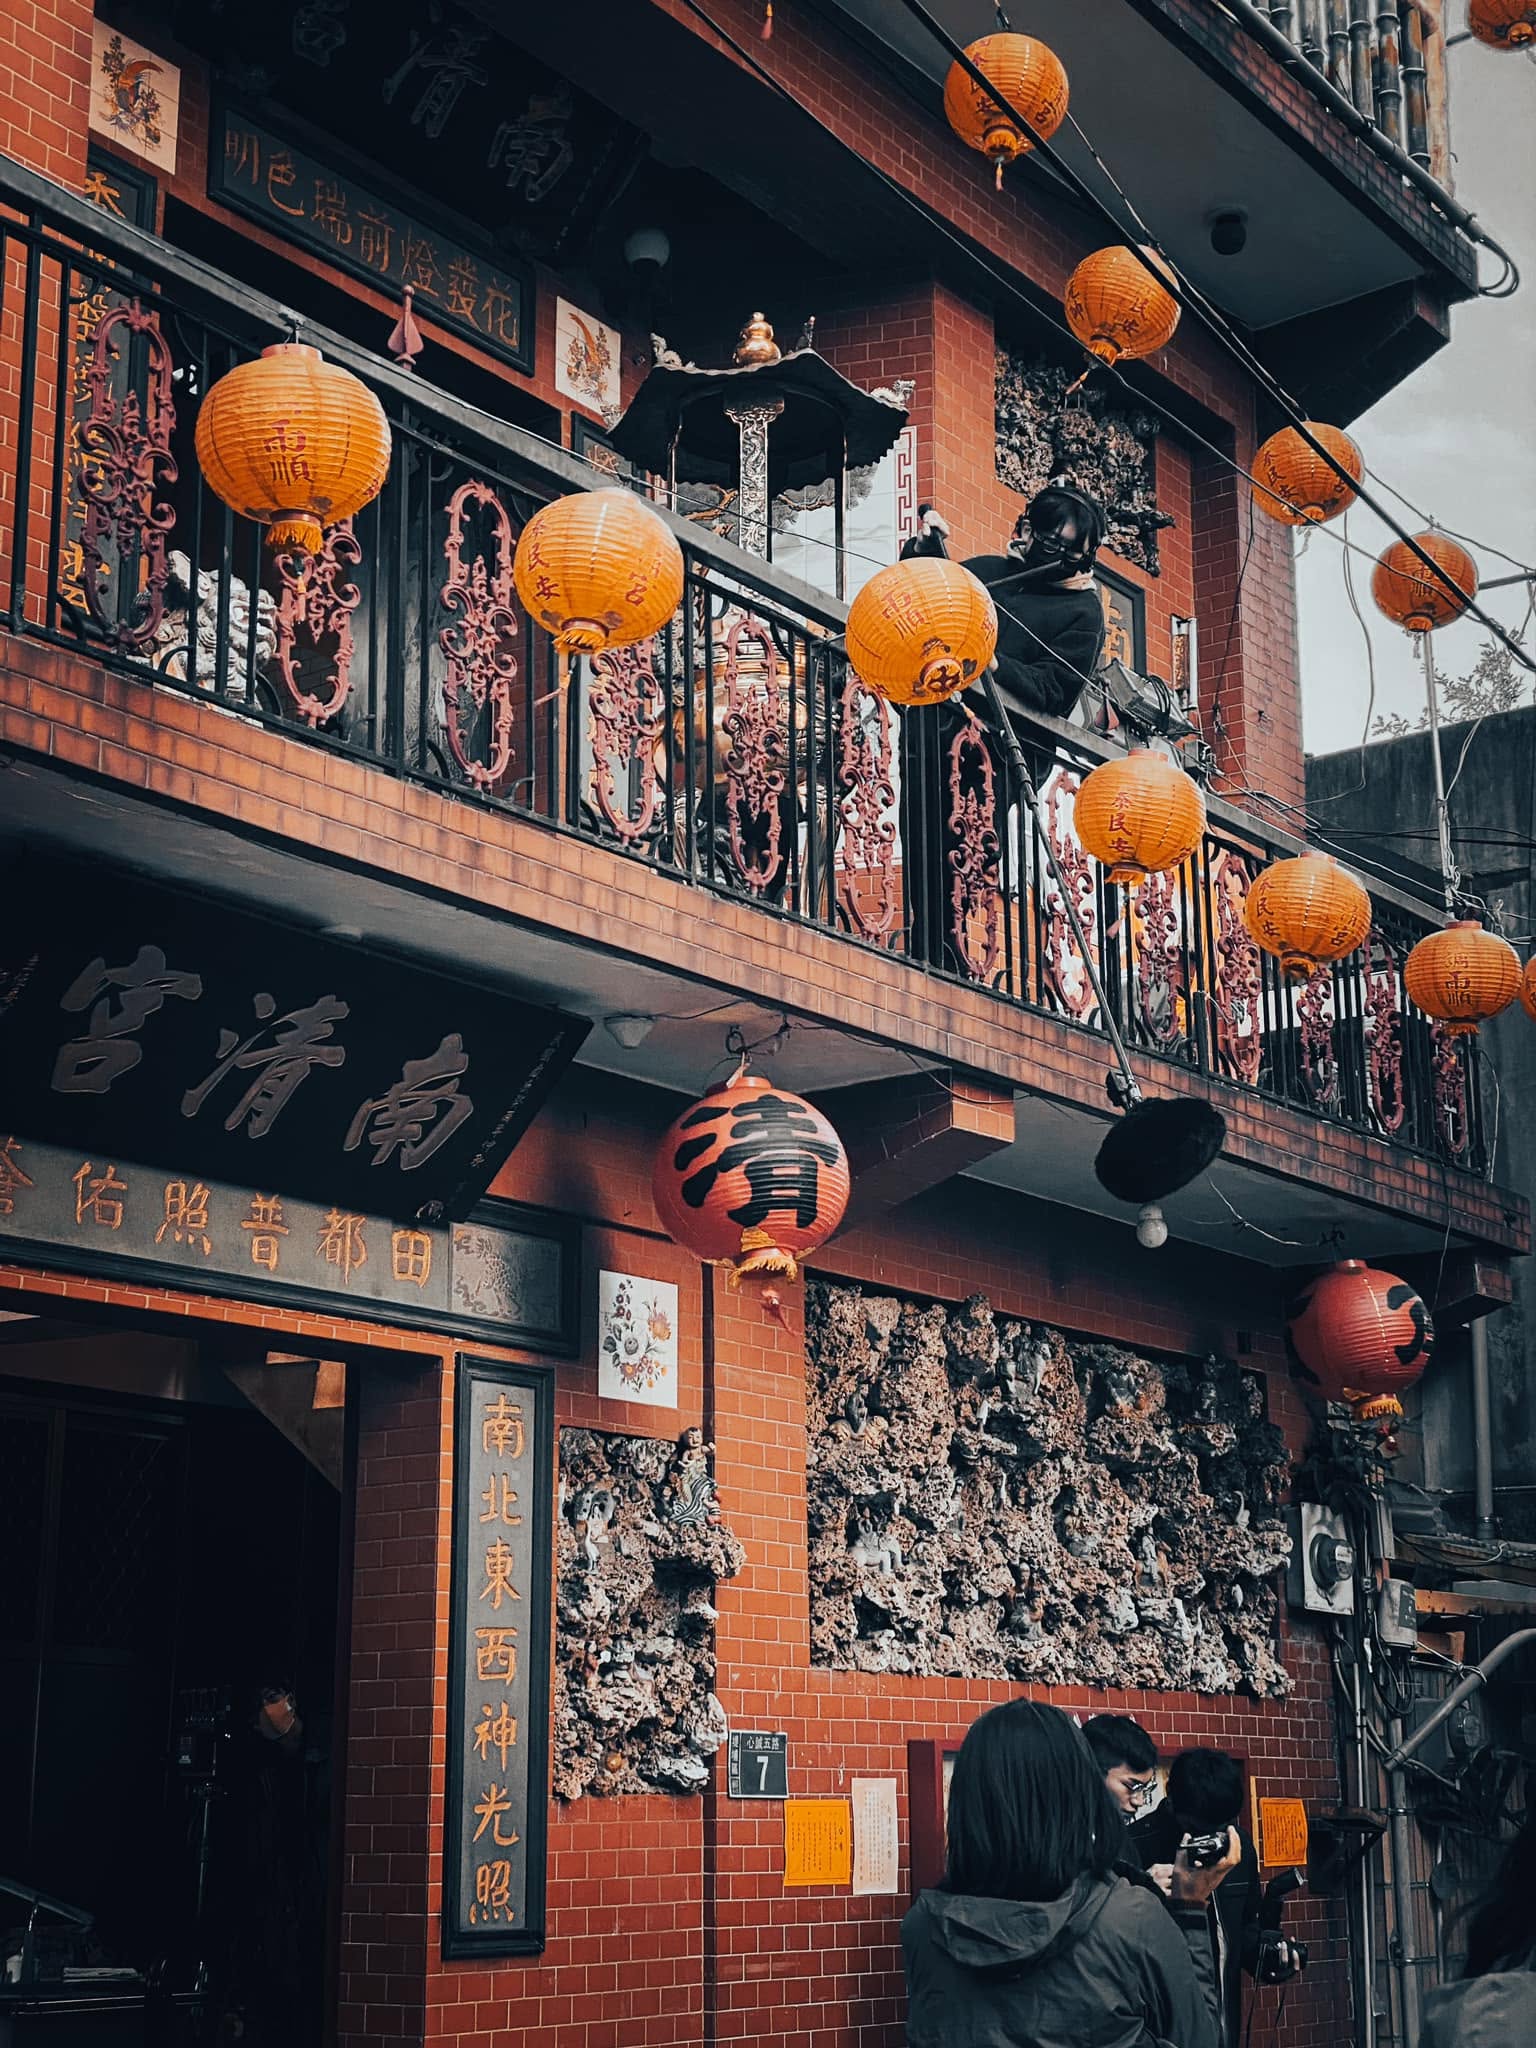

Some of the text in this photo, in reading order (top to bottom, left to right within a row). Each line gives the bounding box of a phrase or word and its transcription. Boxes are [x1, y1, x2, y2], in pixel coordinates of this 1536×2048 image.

[51, 944, 474, 1171] 南清宮
[674, 1094, 839, 1229] 清
[469, 1393, 525, 1924] 南北東西神光照
[756, 1755, 769, 1791] 7
